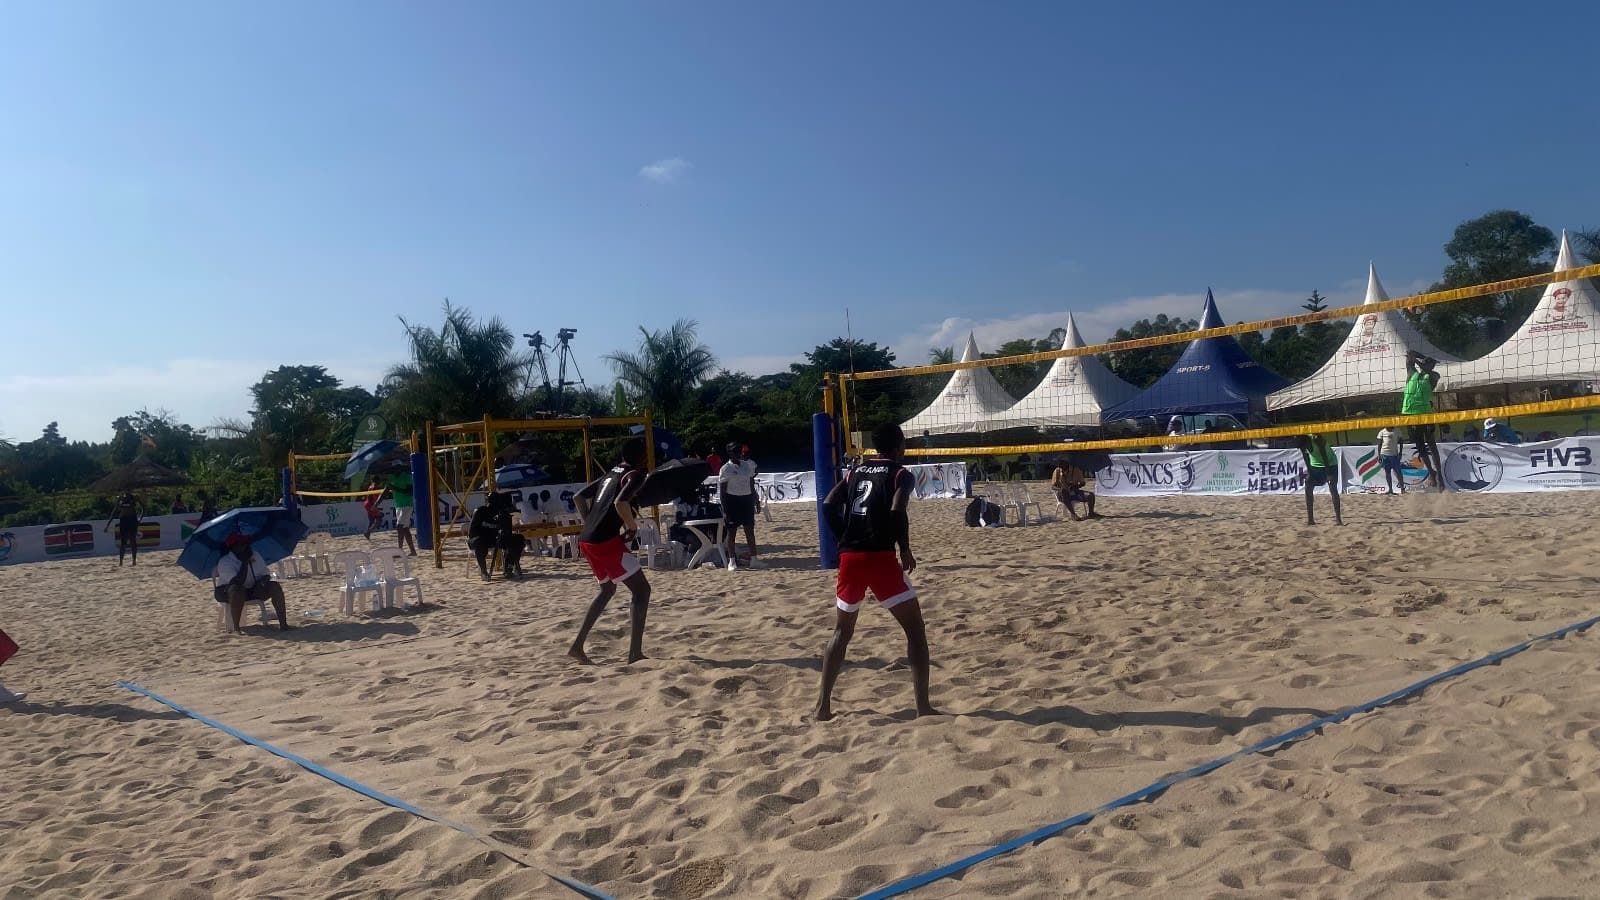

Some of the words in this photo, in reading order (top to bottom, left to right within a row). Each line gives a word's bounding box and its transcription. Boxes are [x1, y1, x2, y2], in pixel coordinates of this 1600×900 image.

[1529, 446, 1593, 468] FIVB
[1247, 461, 1298, 476] S-TEAM
[1247, 477, 1299, 492] MEDIA
[852, 480, 873, 515] 2
